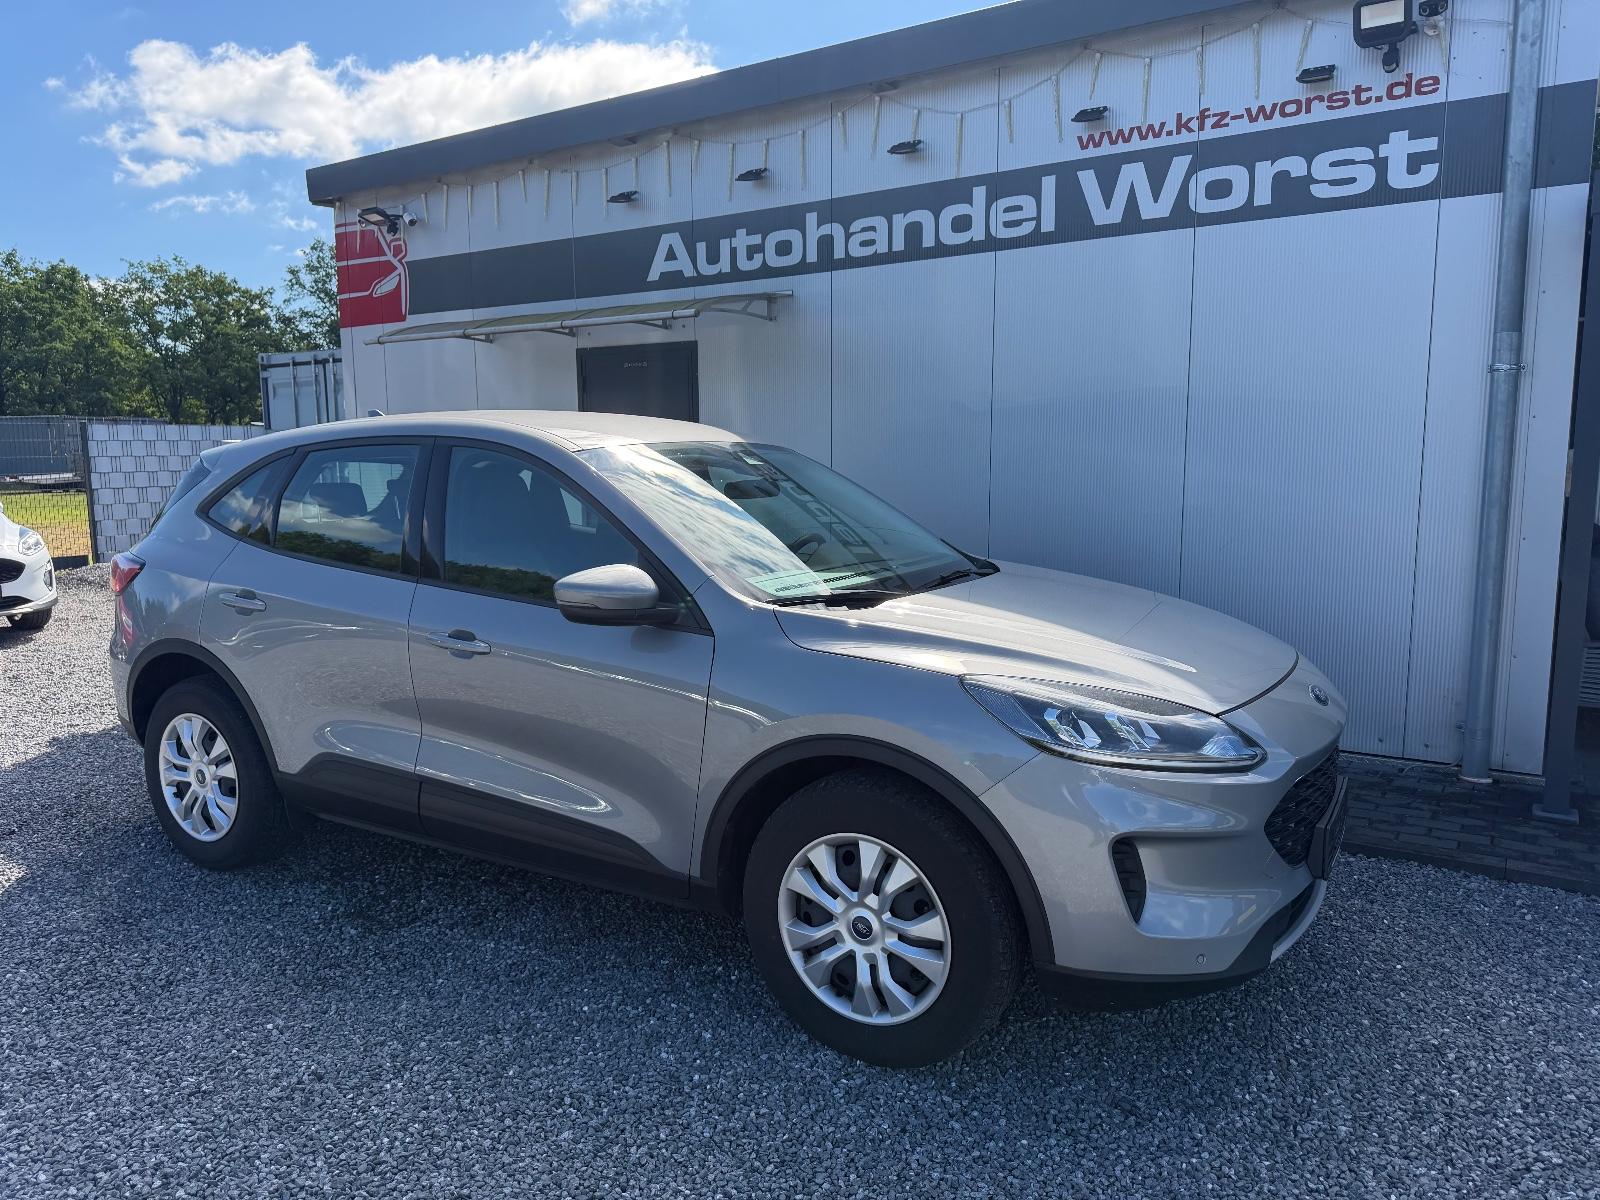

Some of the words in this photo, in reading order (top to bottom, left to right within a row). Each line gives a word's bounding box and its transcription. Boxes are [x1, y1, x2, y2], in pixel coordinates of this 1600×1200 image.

[1077, 73, 1440, 150] www.kfz-worst.de
[647, 175, 1056, 282] Autohandel
[1077, 130, 1439, 226] Worst
